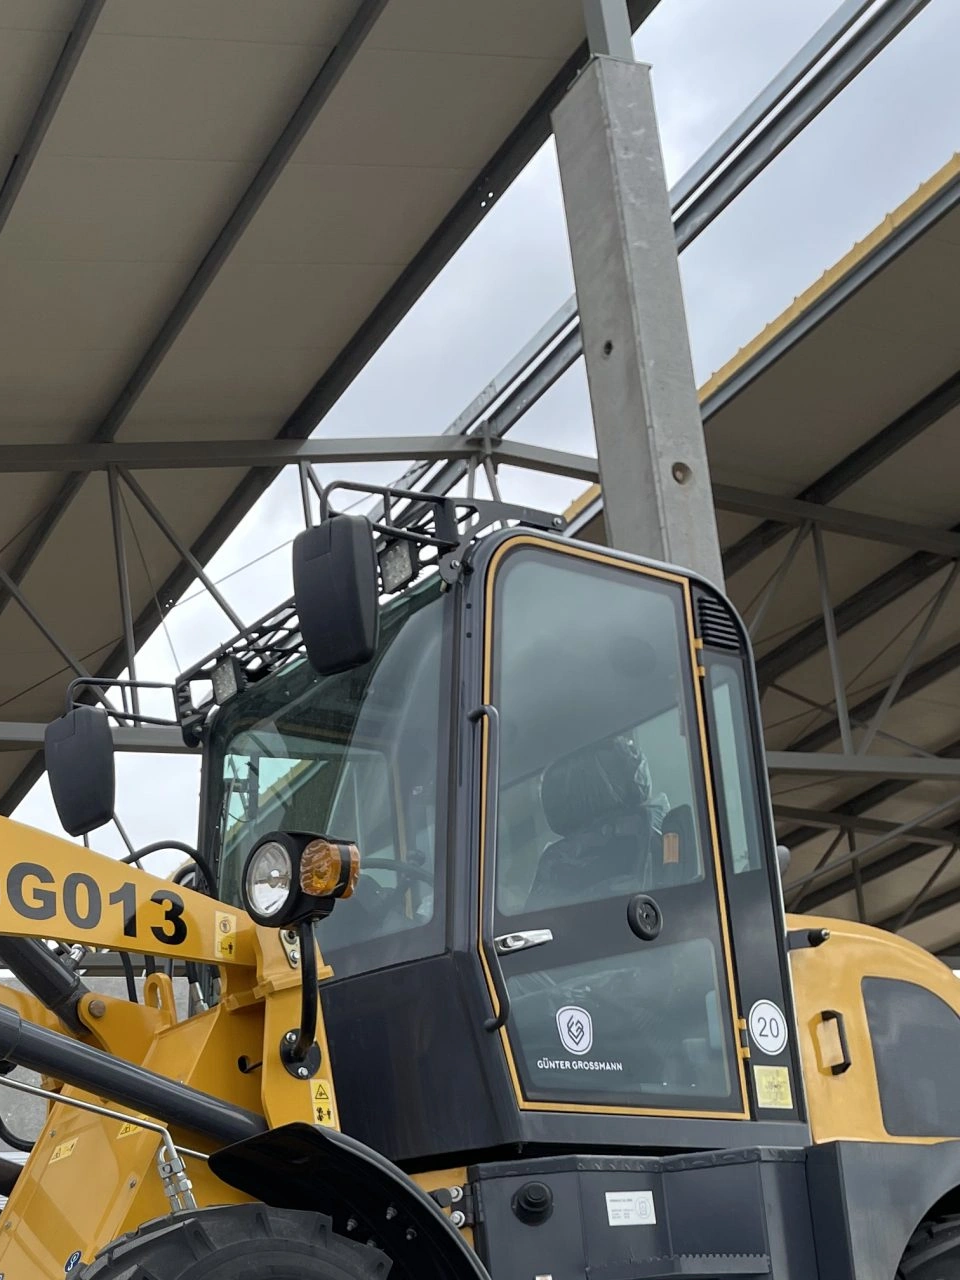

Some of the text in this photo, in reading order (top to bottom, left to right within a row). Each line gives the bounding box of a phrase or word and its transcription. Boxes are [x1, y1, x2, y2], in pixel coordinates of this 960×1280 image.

[757, 1017, 780, 1038] 20
[537, 1057, 623, 1071] GÜNTER GROSSMANN
